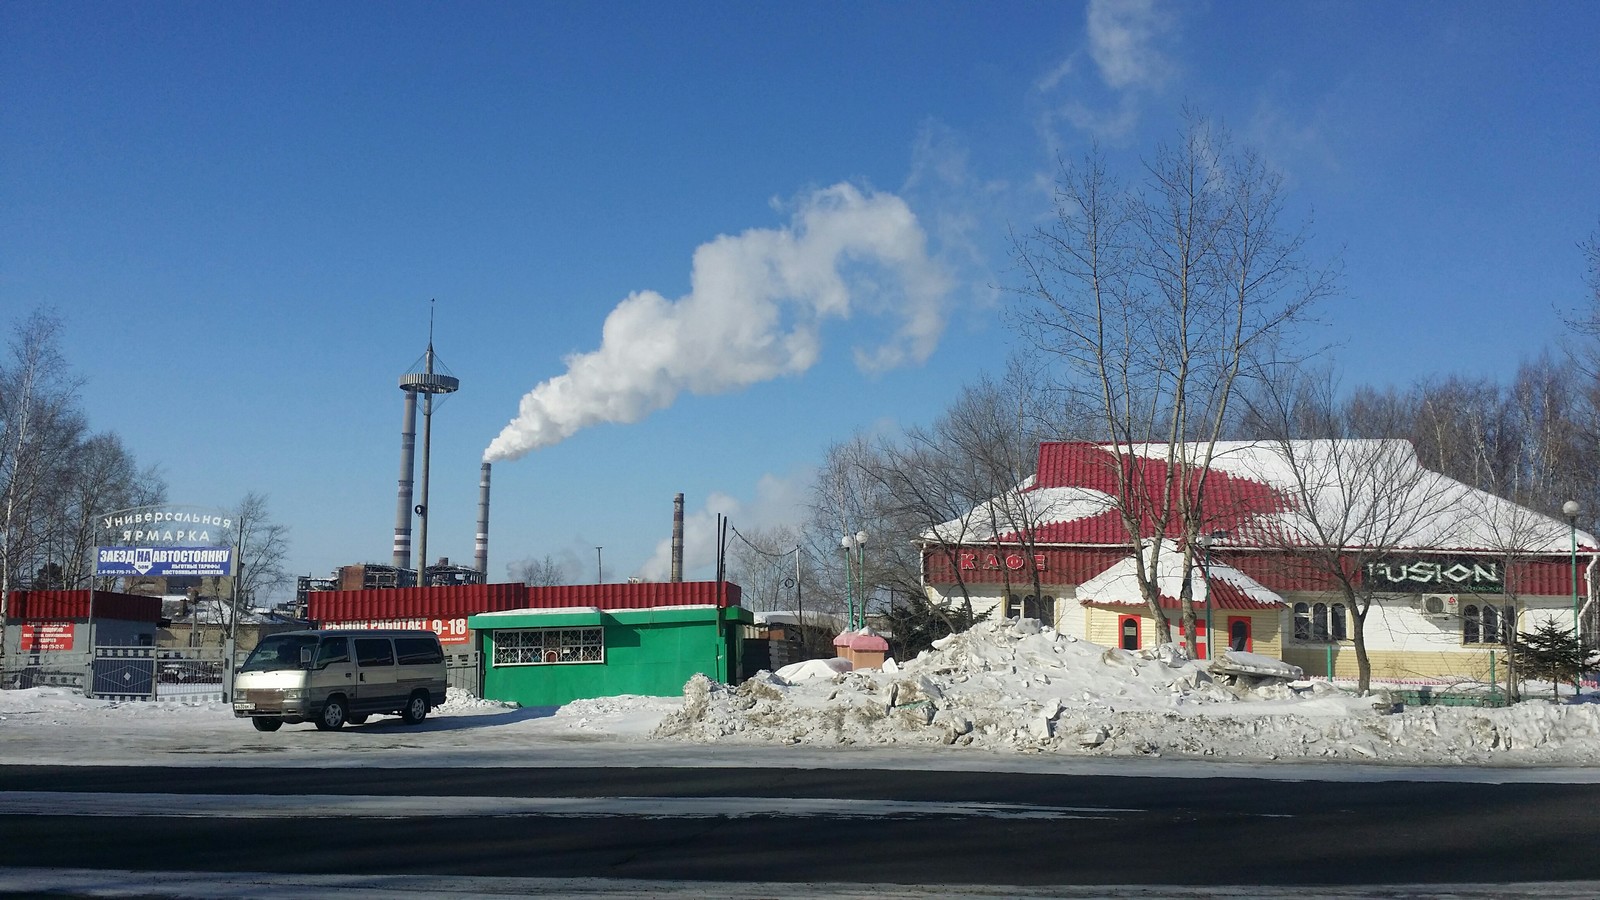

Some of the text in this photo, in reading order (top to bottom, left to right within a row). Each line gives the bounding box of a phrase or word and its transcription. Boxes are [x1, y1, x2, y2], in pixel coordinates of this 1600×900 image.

[104, 512, 232, 529] Универсальная
[123, 530, 210, 541] ЯРМАРКА
[100, 550, 230, 564] ЗАЕЗД НА АВТОСТОЯНКУ
[961, 554, 1046, 571] КАФЕ
[1367, 561, 1499, 583] FUSION
[432, 618, 466, 635] 9-18
